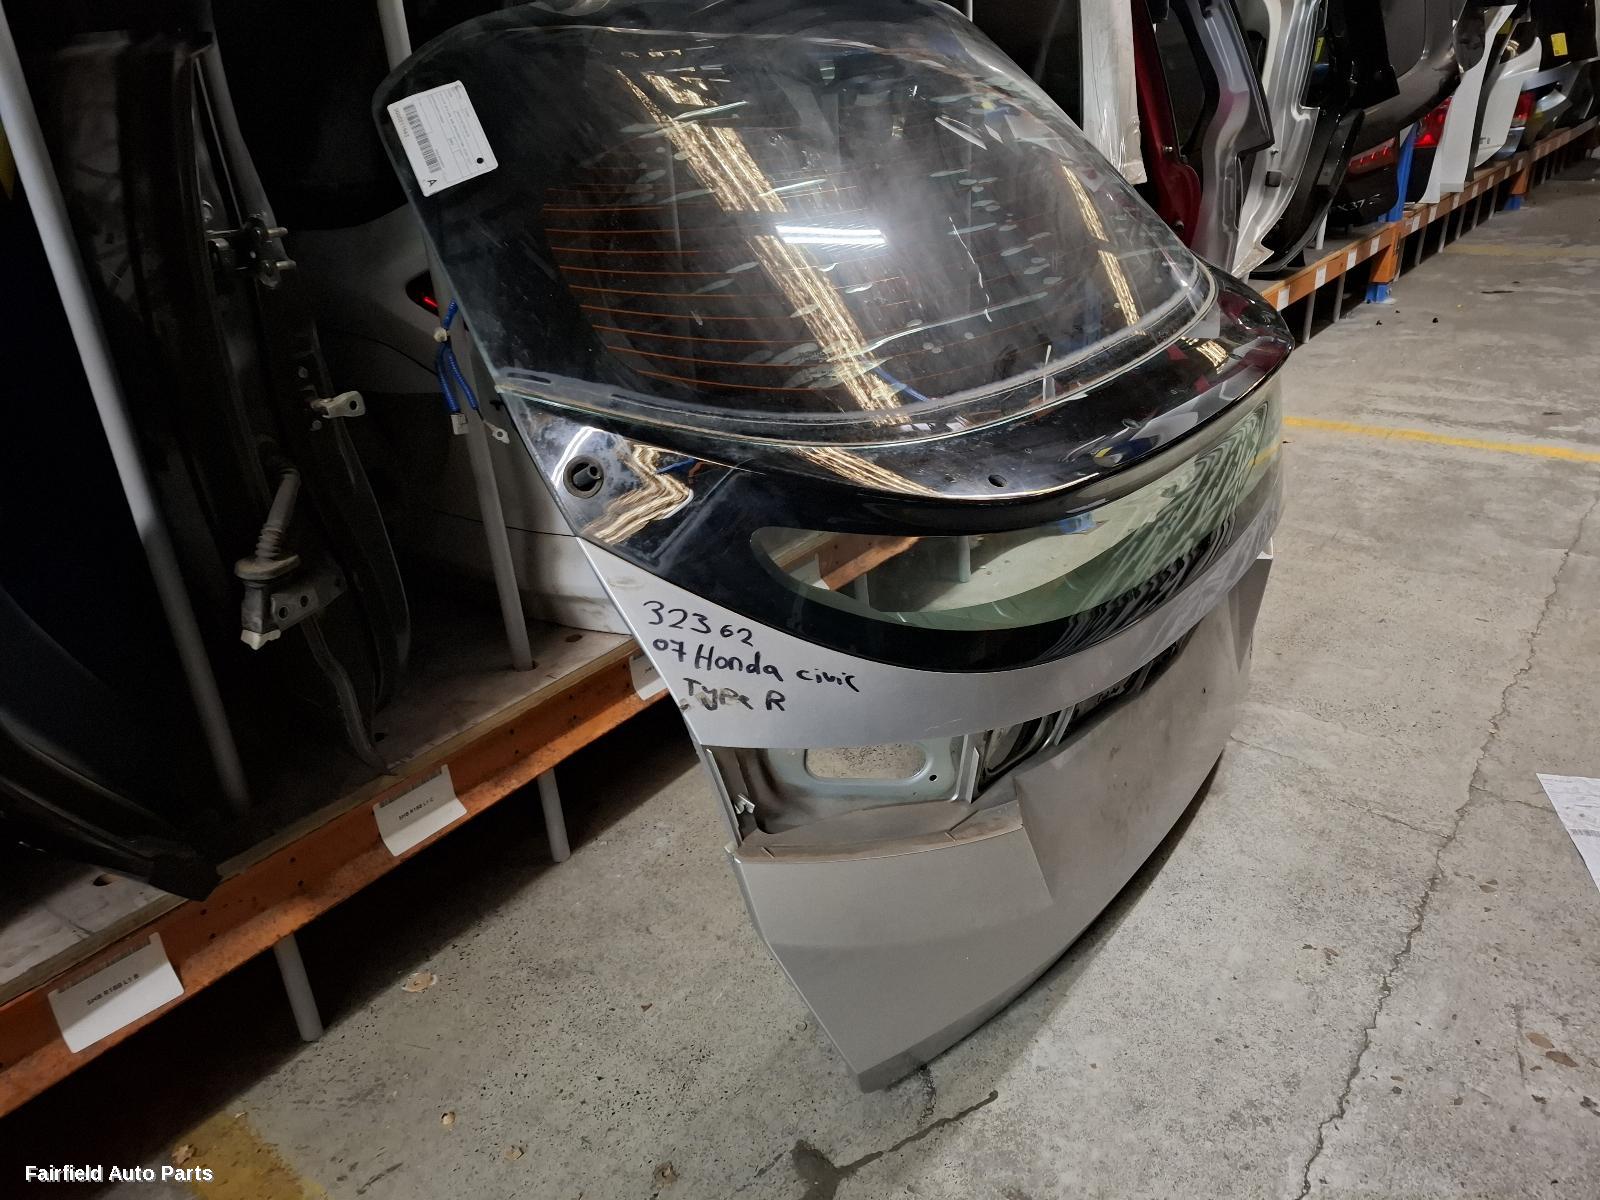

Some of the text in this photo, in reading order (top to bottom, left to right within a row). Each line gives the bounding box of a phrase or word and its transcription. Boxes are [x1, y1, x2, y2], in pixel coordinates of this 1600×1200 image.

[427, 179, 437, 187] A
[643, 600, 754, 648] 32362
[652, 638, 860, 693] 07 Honda civic
[765, 689, 786, 711] R
